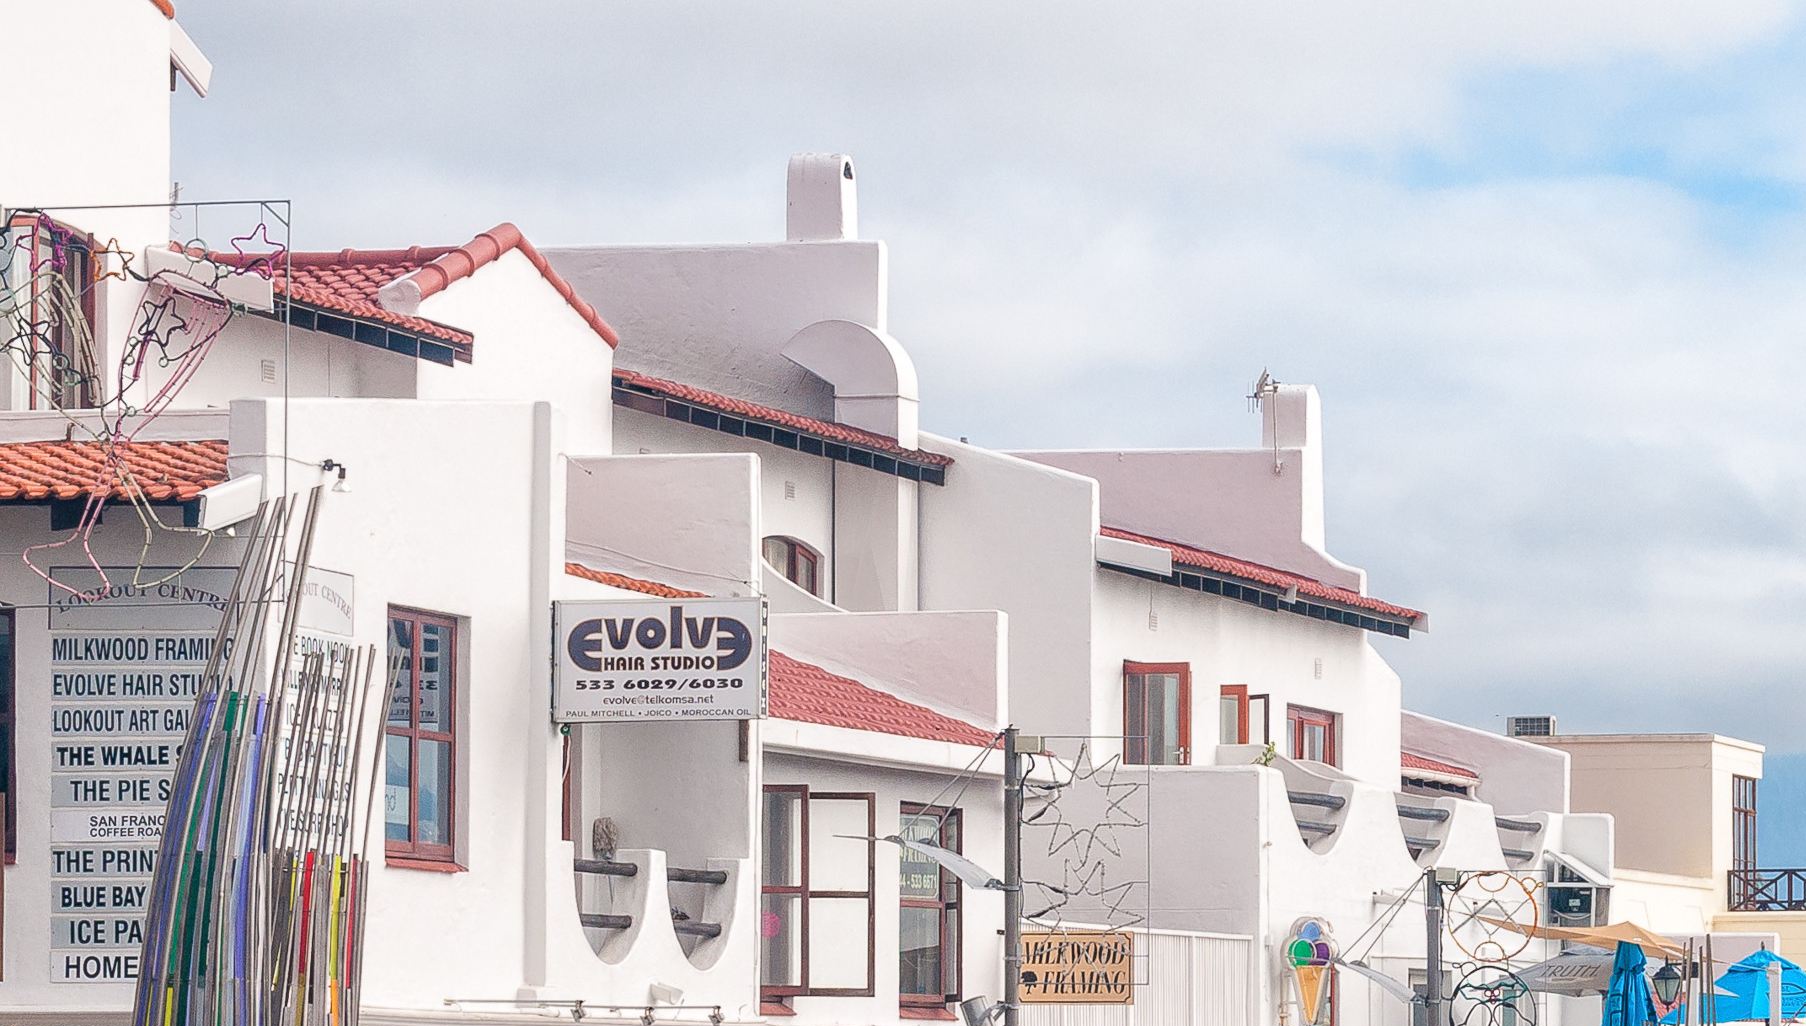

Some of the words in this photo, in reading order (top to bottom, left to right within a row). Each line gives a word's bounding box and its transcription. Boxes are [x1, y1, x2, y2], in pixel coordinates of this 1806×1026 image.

[52, 637, 149, 661] MILKWOOD
[155, 637, 234, 661] FRAMIG
[604, 658, 644, 670] HAIR
[651, 656, 715, 670] STUDIO
[53, 674, 116, 696] EVOLVE
[123, 674, 163, 696] HAIR
[576, 680, 614, 690] 533
[623, 679, 743, 689] 6029/6030
[603, 694, 713, 705] evolve@telkomsa.net
[53, 710, 124, 732] LOOKOUT
[129, 710, 159, 732] ART
[737, 708, 750, 716] OIL
[56, 747, 95, 766] THE
[101, 746, 169, 766] WHALE
[71, 780, 110, 801] THE
[119, 780, 150, 801] PIE
[90, 816, 117, 827] SAN
[90, 827, 134, 837] COFFEE
[53, 851, 94, 873] THE
[61, 886, 106, 908] BLUE
[113, 886, 146, 907] BAY
[71, 921, 105, 944] ICE
[1042, 970, 1126, 994] FRAMING
